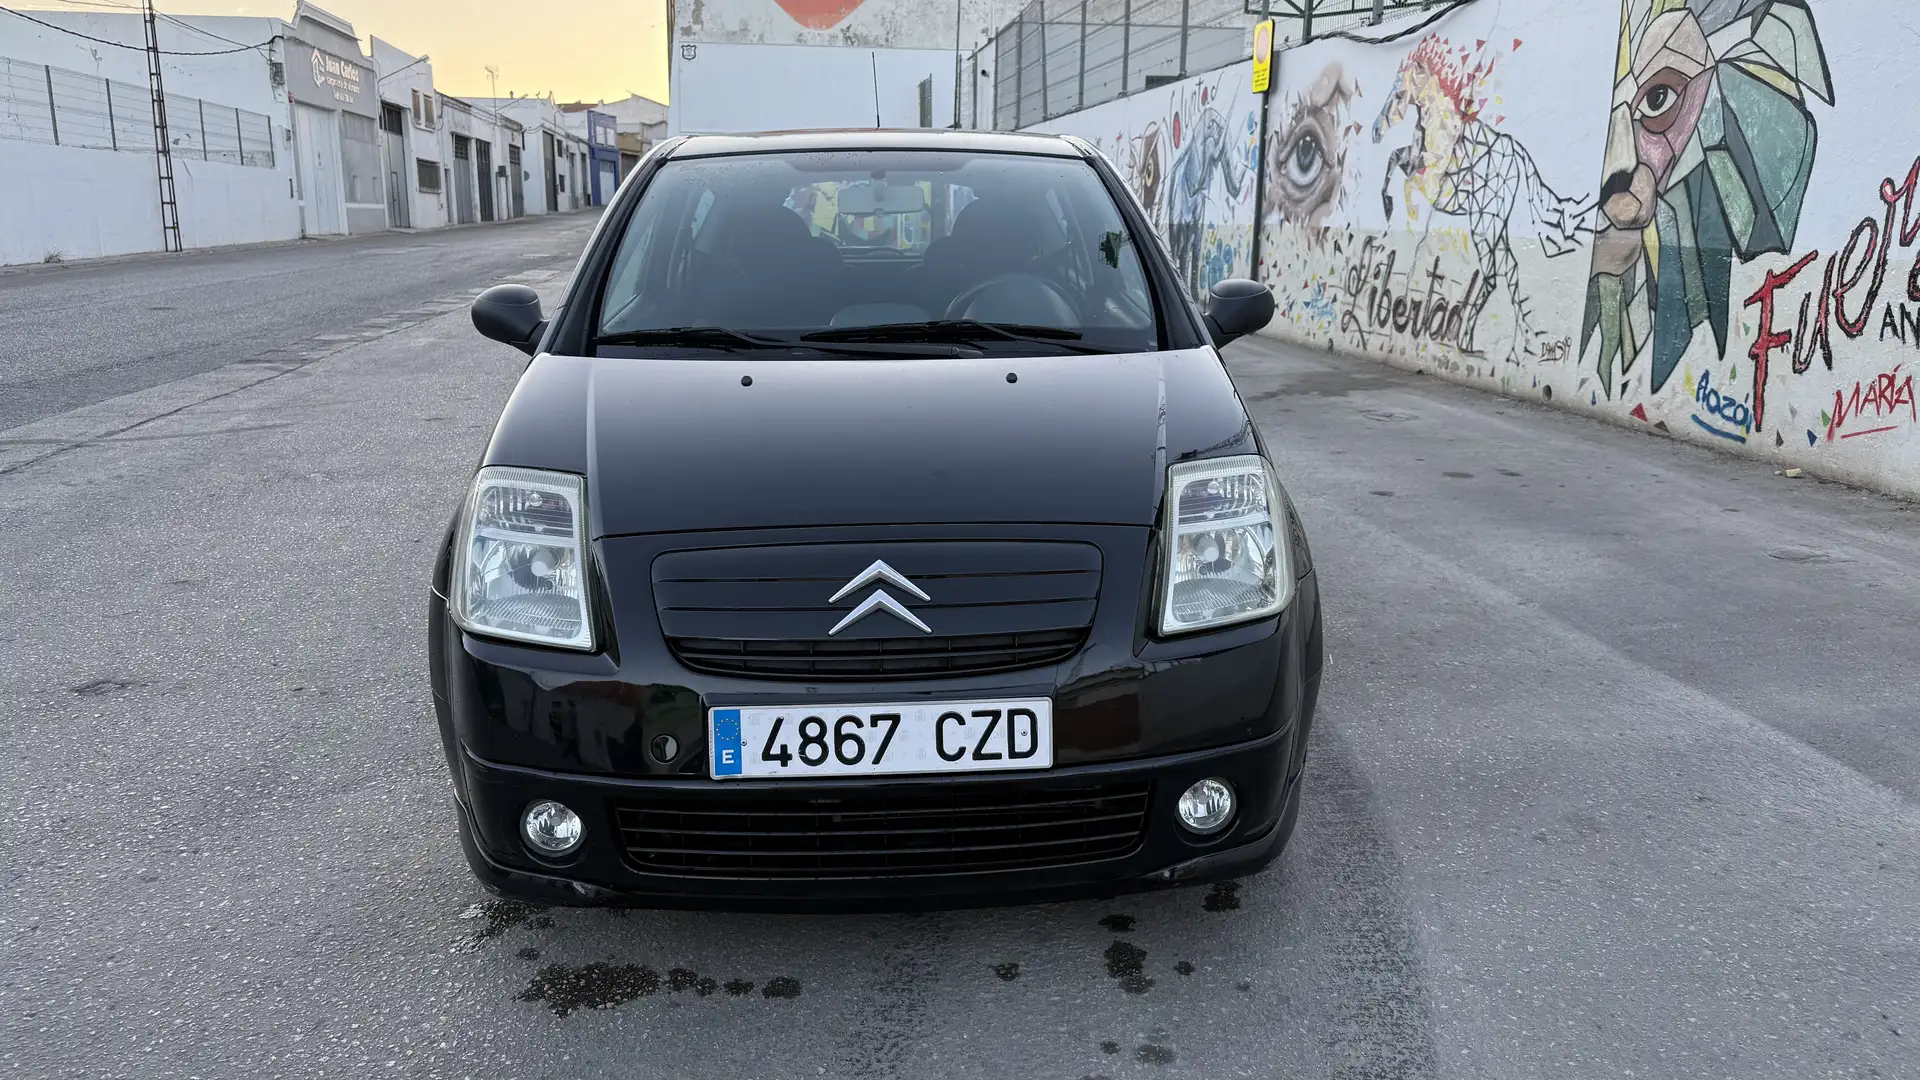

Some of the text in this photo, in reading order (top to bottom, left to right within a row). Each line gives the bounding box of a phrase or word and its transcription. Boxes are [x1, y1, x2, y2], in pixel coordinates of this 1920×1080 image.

[1743, 155, 1920, 432] Fuer
[722, 749, 735, 764] E
[761, 707, 1039, 767] 4867 CZD
